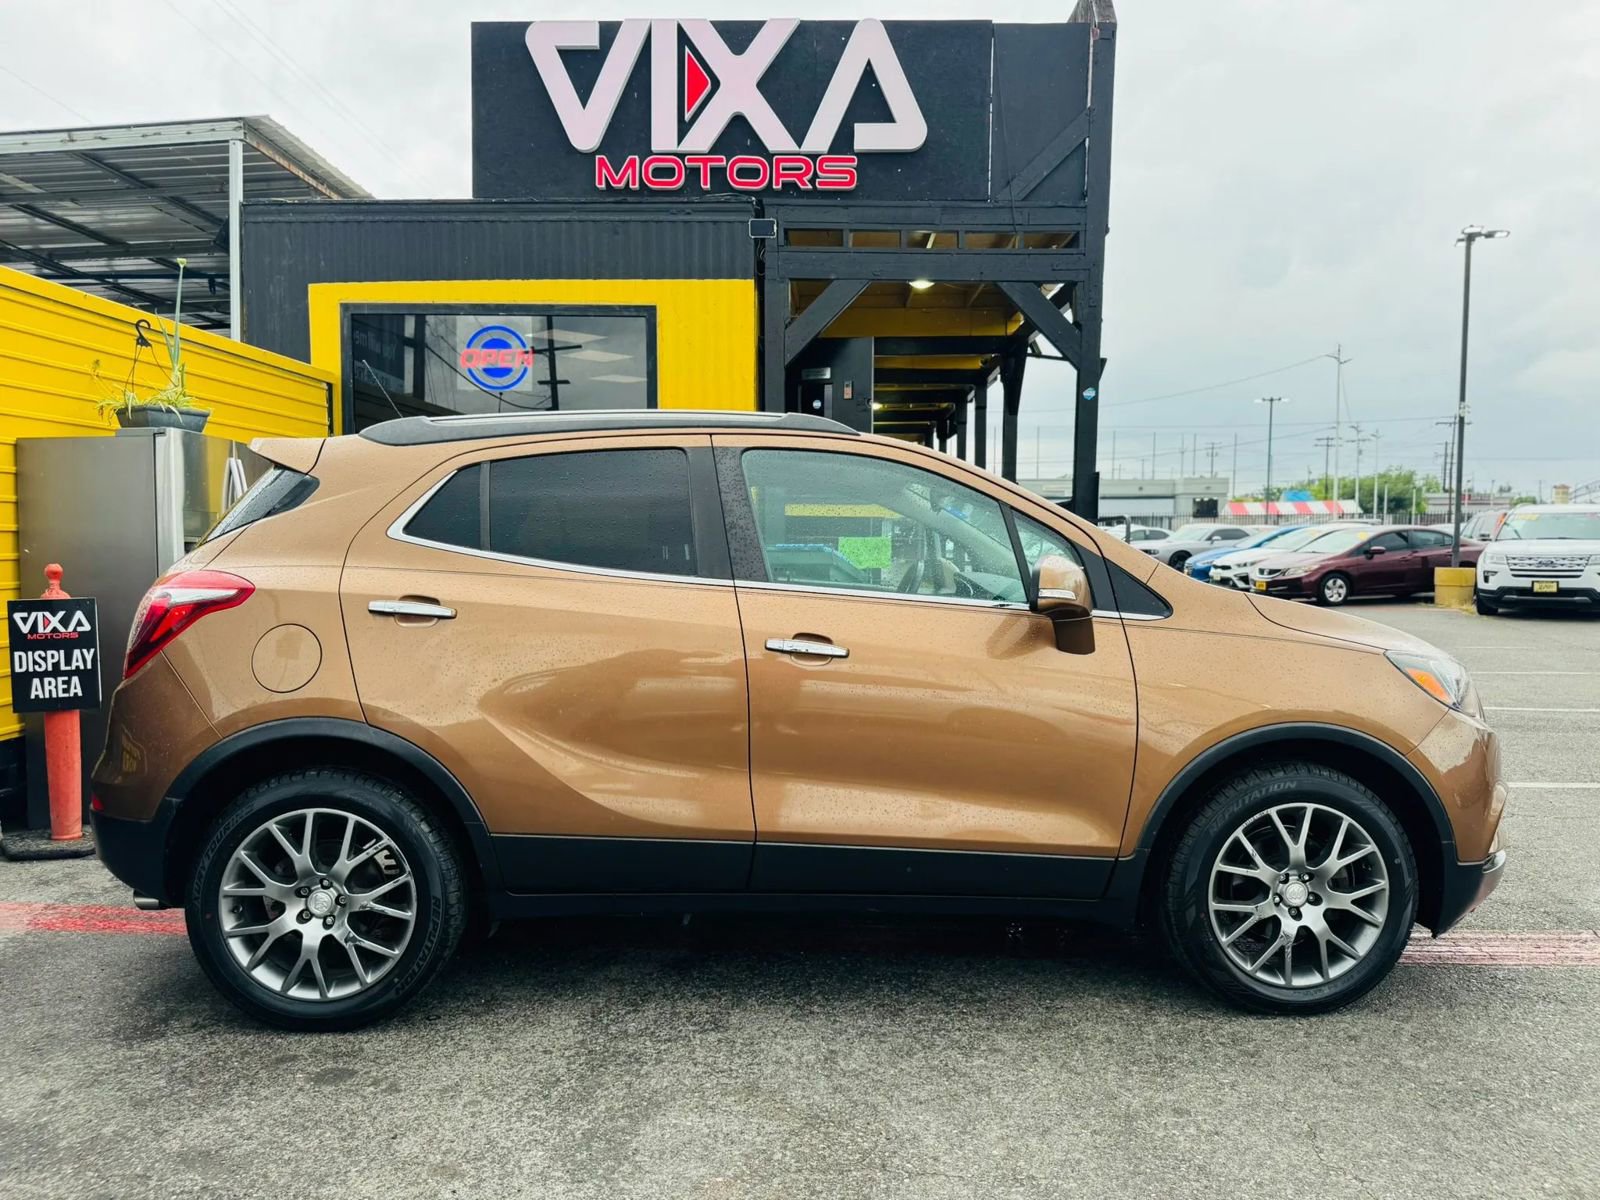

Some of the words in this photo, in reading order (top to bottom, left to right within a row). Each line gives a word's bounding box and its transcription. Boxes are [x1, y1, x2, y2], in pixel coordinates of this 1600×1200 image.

[525, 18, 928, 153] VIXA
[595, 155, 857, 191] MOTORS
[460, 348, 534, 368] OPEN
[12, 610, 91, 634] VIXA
[27, 632, 79, 640] MOTORS
[14, 648, 95, 673] DISPLAY
[30, 676, 82, 699] AREA
[1206, 781, 1297, 836] REPUTATION
[394, 895, 441, 995] REPUTATION
